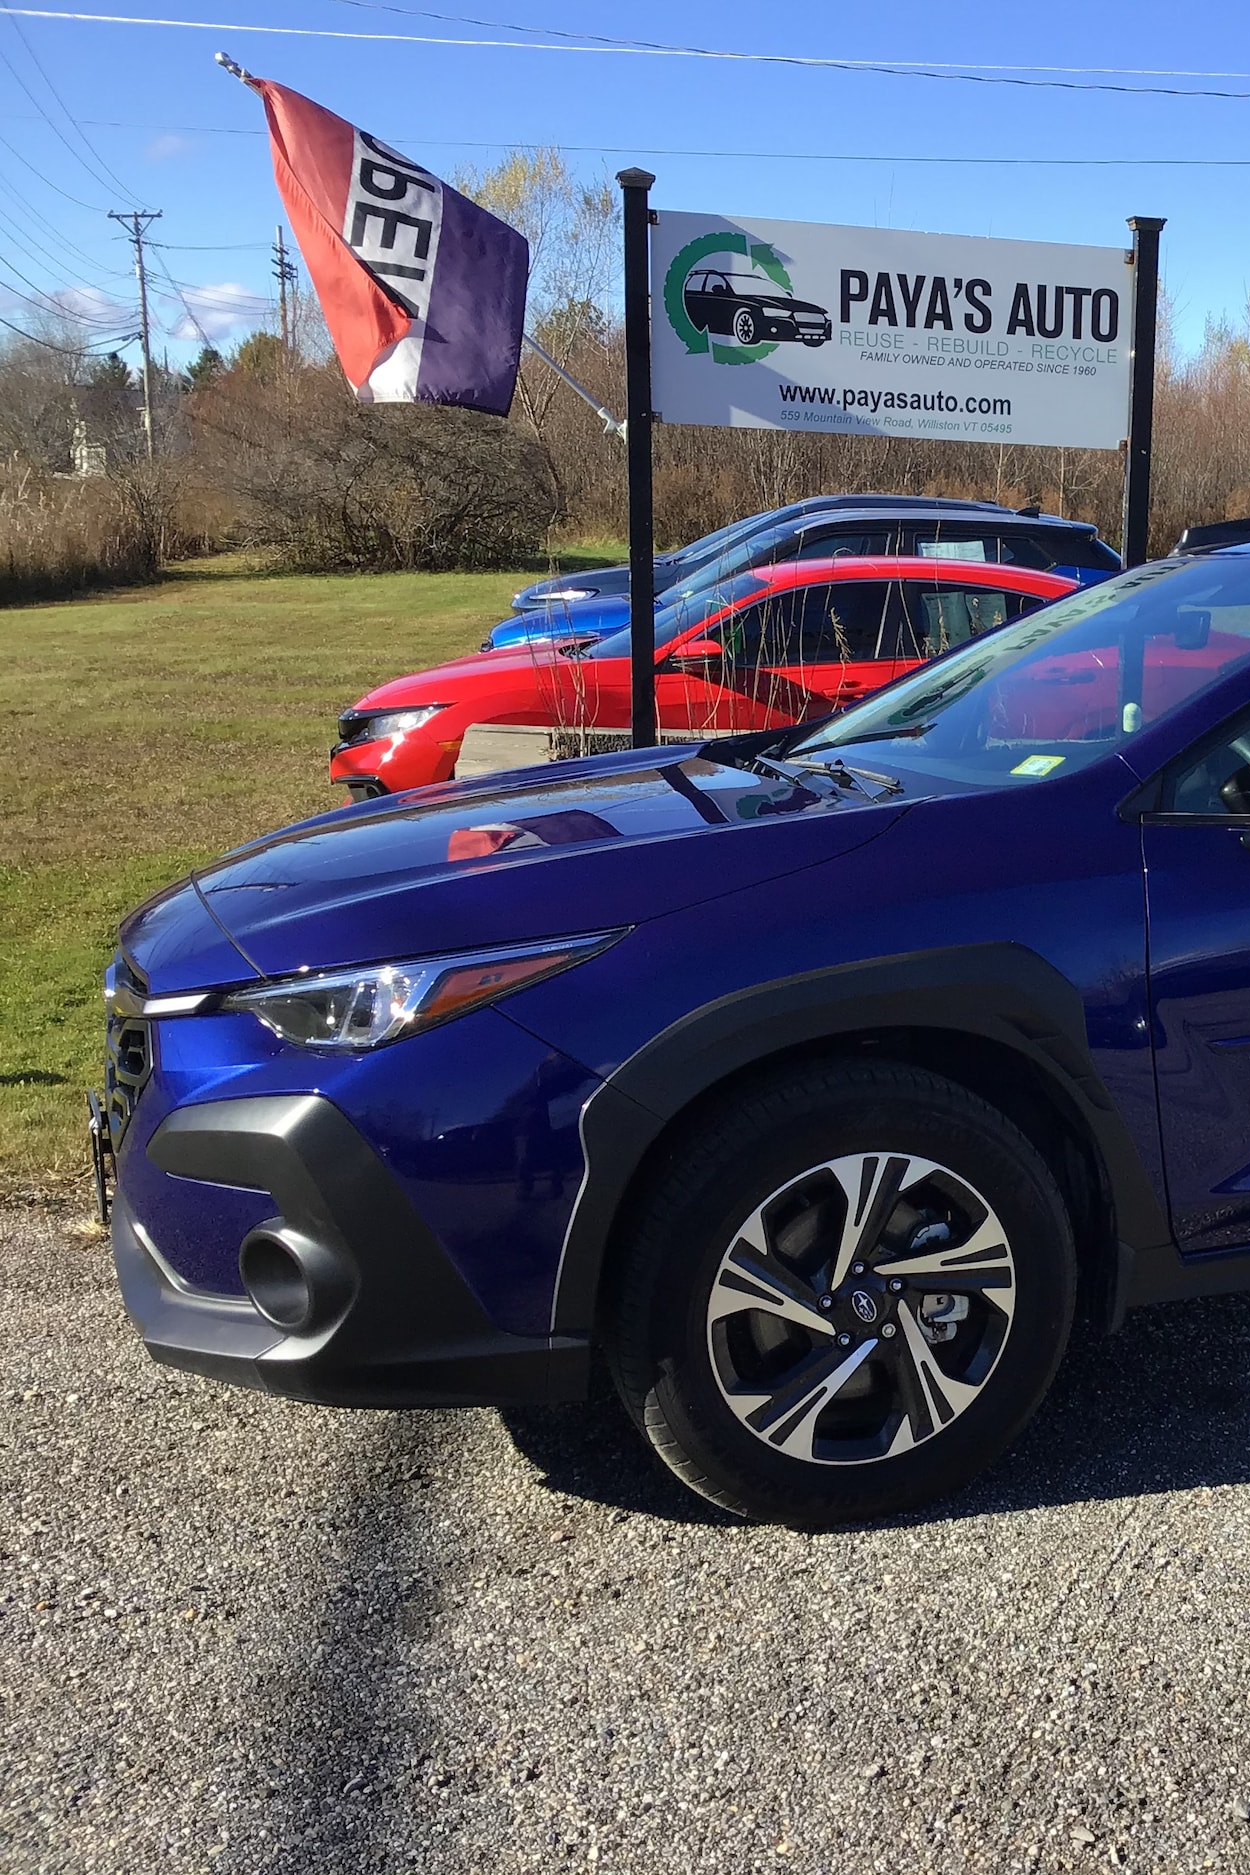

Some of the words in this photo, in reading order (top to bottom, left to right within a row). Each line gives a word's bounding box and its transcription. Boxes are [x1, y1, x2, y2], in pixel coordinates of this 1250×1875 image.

[840, 269, 992, 334] PAYA'S
[1006, 283, 1119, 342] AUTO
[839, 330, 904, 349] REUSE
[927, 337, 1009, 356] REBUILD
[1031, 344, 1118, 364] RECYCLE
[860, 351, 901, 363] FAMILY
[902, 354, 945, 366] OWNED
[947, 357, 972, 368] AND
[974, 359, 1034, 372] OPERATED
[1036, 363, 1070, 375] SINCE
[1072, 366, 1097, 376] 1960
[779, 384, 1012, 415] www.payasauto.com
[780, 410, 800, 421] 559
[803, 411, 852, 424] Mountain
[855, 415, 881, 426] View
[883, 417, 913, 429] Road,
[918, 419, 960, 431] Williston
[962, 421, 979, 432] VT
[980, 423, 1012, 434] 05495
